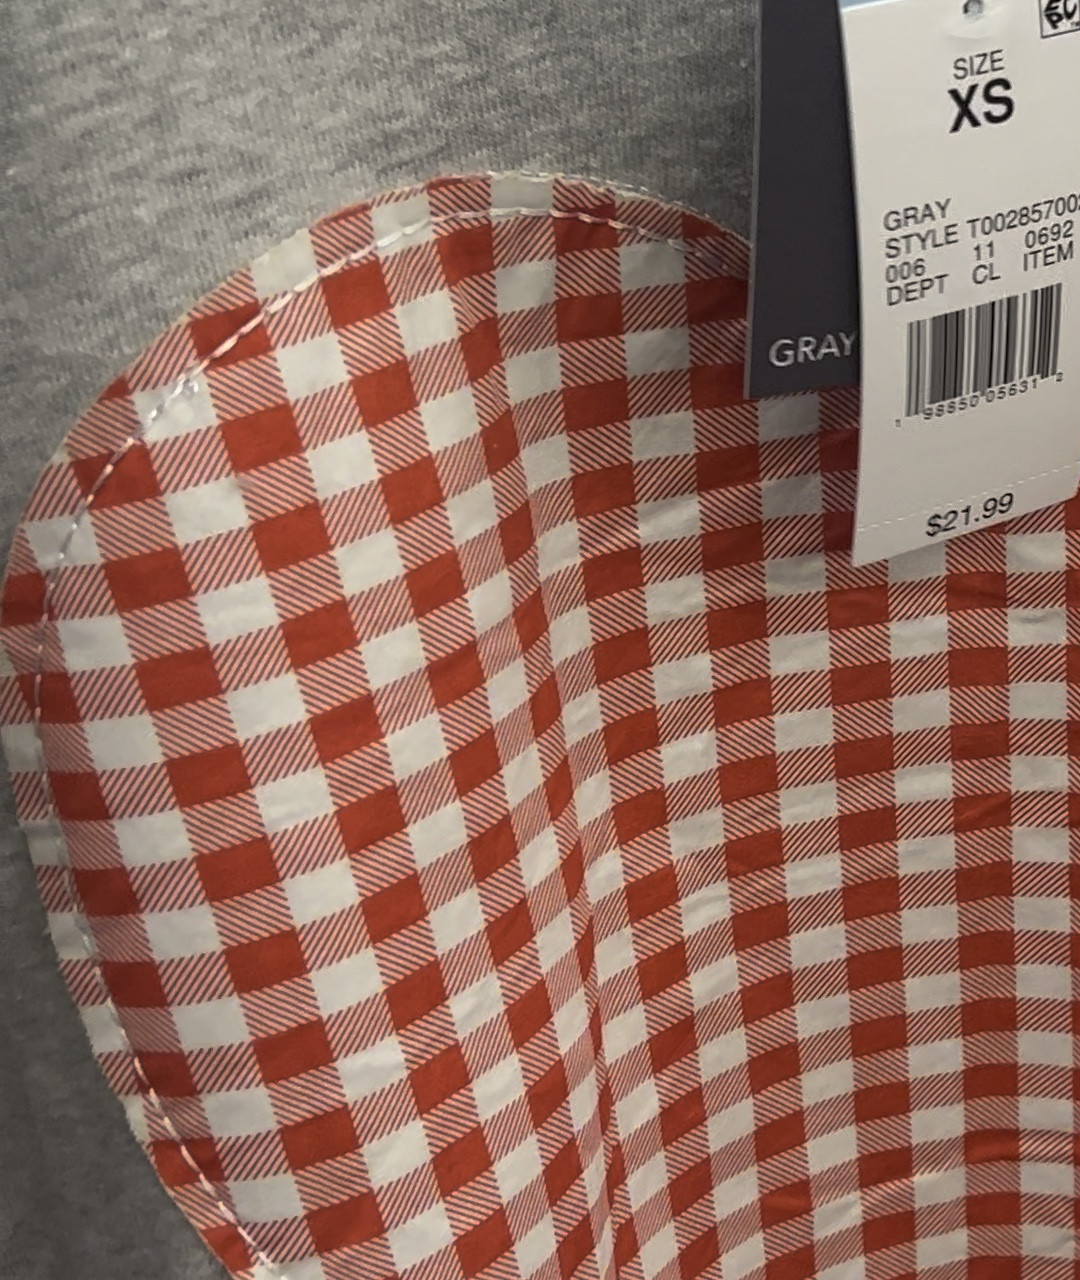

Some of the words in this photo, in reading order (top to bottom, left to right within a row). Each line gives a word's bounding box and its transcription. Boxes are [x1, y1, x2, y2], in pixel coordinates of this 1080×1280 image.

[952, 49, 1005, 80] SIZE
[948, 77, 1015, 134] XS
[883, 198, 951, 231] GRAY
[885, 223, 958, 259] STYLE
[885, 258, 926, 283] 006
[973, 240, 994, 261] 11
[1024, 219, 1074, 248] 0692
[887, 274, 949, 306] DEPT
[972, 262, 1001, 284] CL
[1023, 241, 1074, 272] ITEM
[769, 331, 857, 367] GRAY
[925, 493, 1014, 537] $21.99
